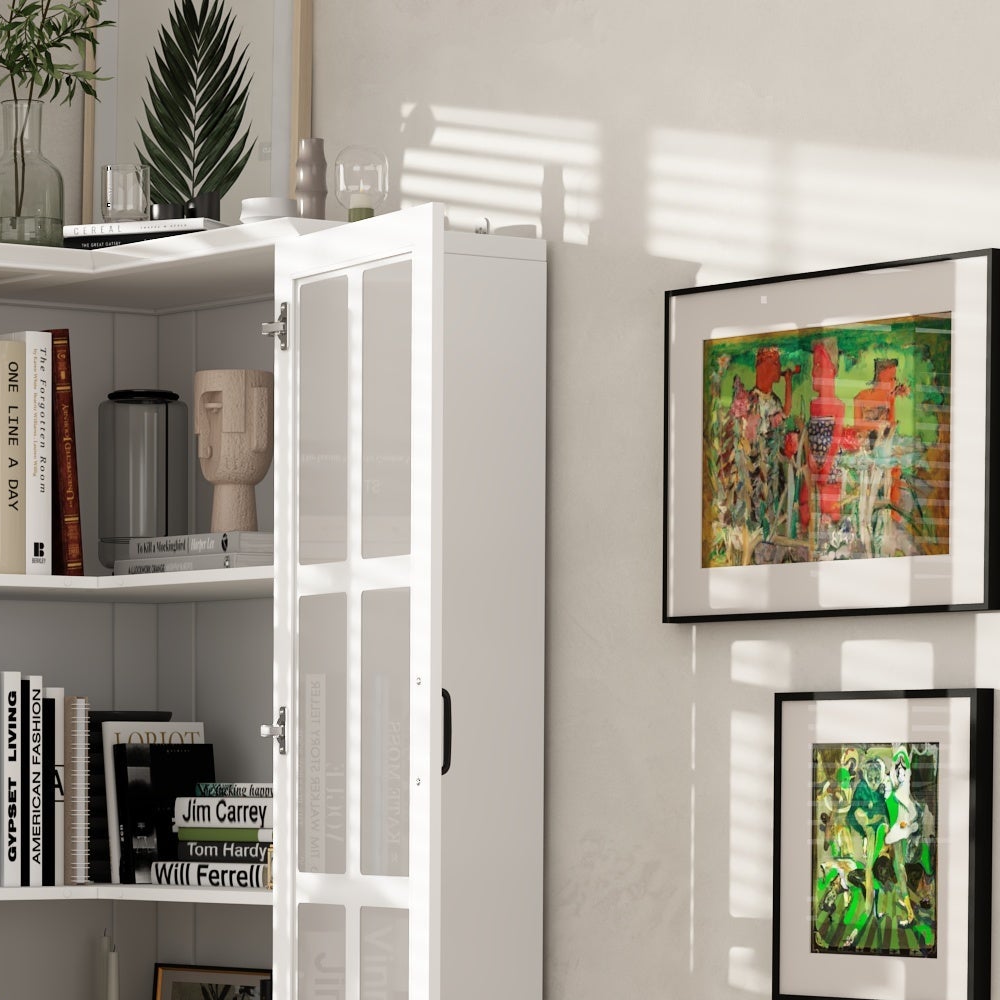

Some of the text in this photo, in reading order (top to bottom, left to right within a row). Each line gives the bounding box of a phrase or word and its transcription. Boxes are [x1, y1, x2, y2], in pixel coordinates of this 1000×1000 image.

[74, 225, 122, 236] CEREAL
[8, 361, 19, 511] ONE LINE A DAY
[38, 380, 47, 448] Forgotten
[8, 690, 18, 862] GYPSET LIVING
[32, 688, 41, 864] AMERICAN FASHION
[182, 800, 267, 828] Jim Carrey
[155, 863, 260, 888] Will Ferrell
[187, 842, 268, 862] Tom Hardy
